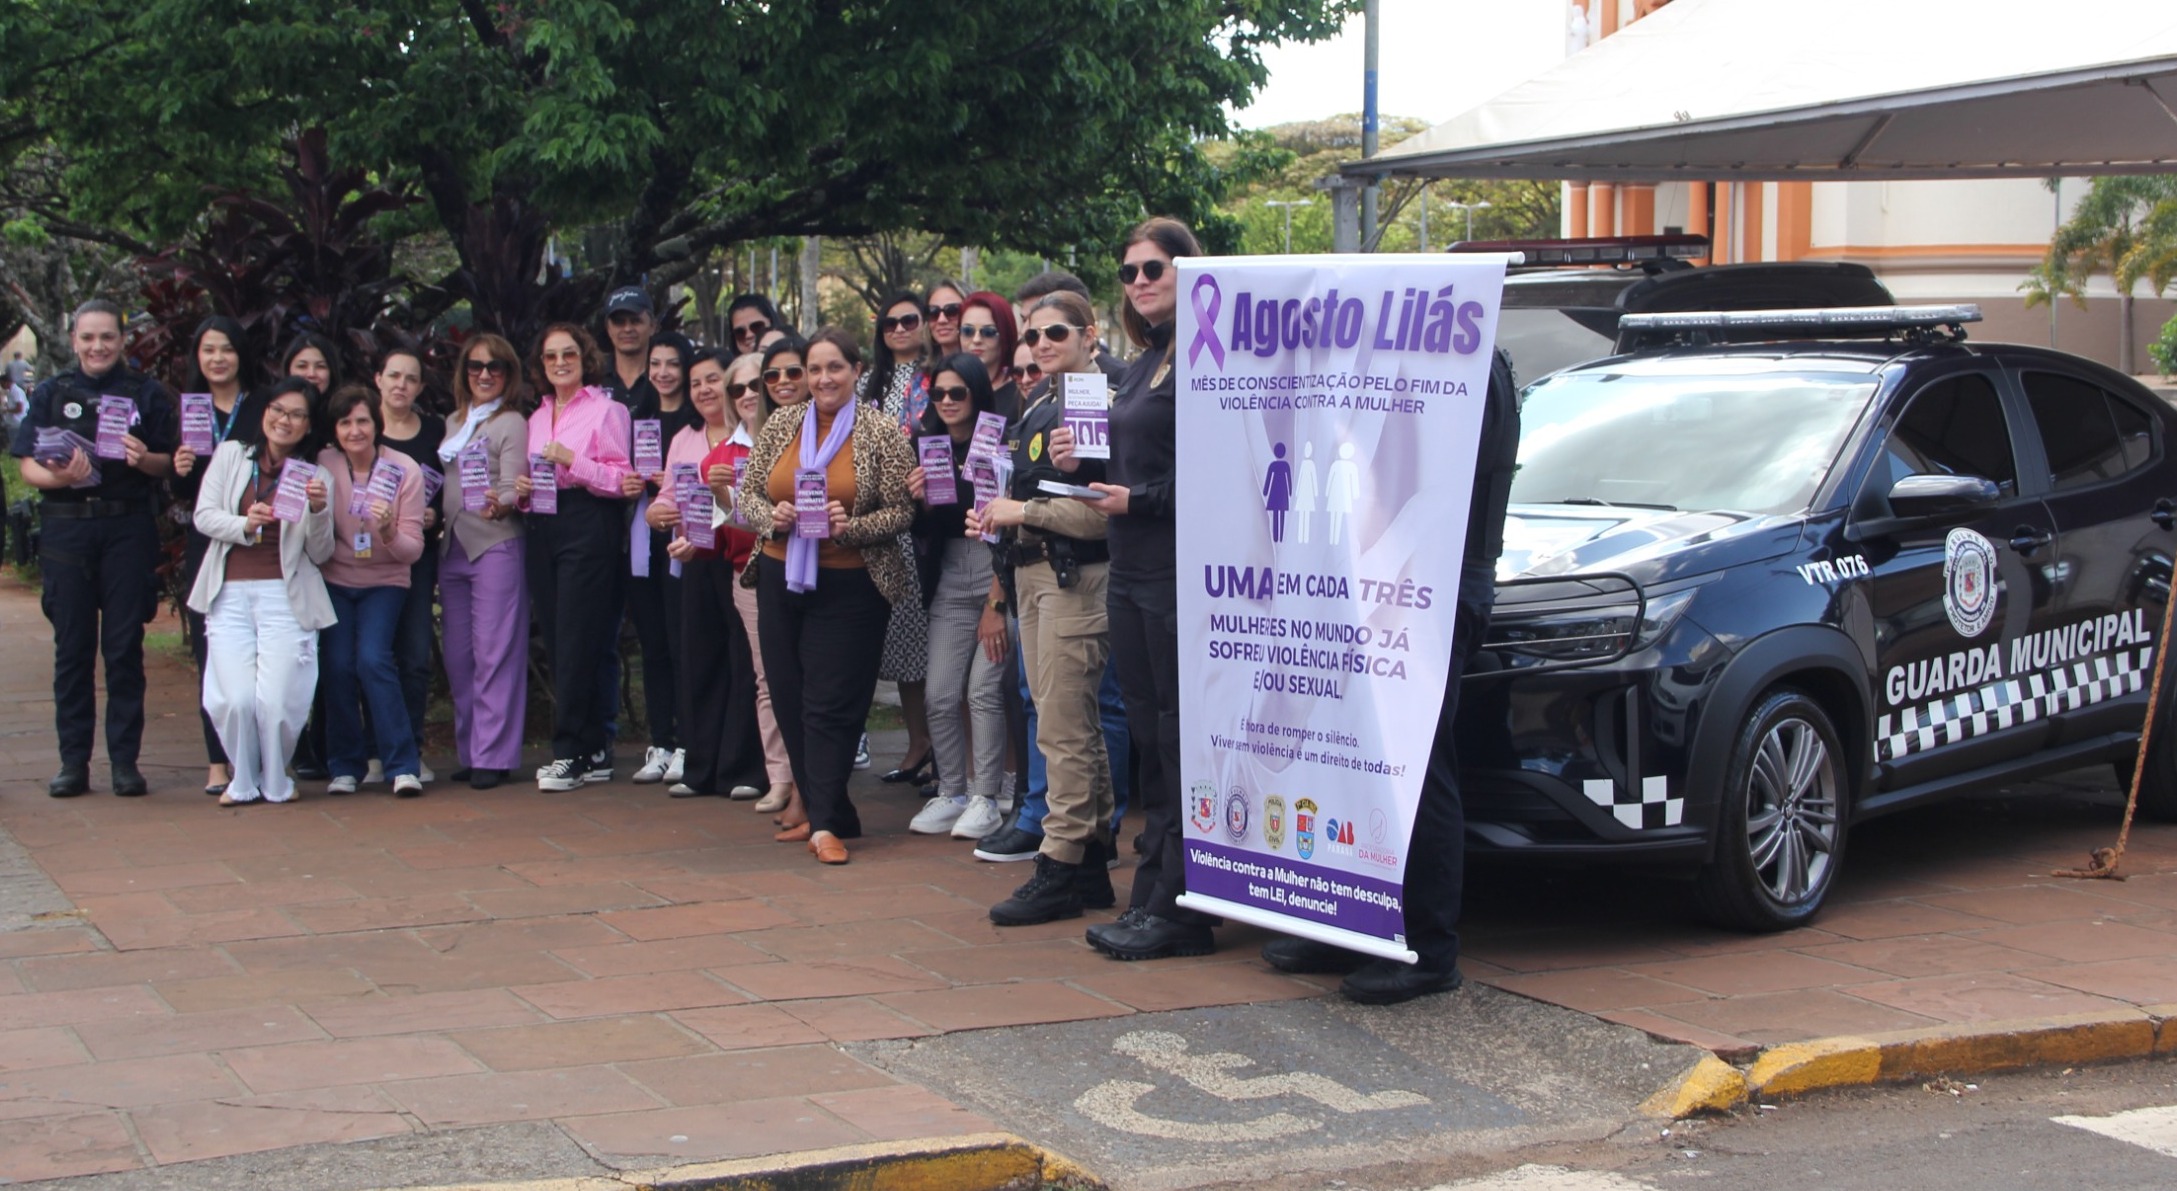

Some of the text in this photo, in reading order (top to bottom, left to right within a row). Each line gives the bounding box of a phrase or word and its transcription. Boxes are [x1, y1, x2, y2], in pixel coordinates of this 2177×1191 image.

[1231, 284, 1484, 358] Agosto Lilás
[1191, 372, 1468, 396] MÊS DE CONSCIENTIZAÇÃO PELO FIM DA
[1220, 394, 1425, 414] VIOLÊNCIA CONTRA A MULHER
[1204, 564, 1433, 610] UMA EM CADA TRÊS
[1796, 554, 1868, 586] VTR 076
[1210, 614, 1410, 652] MULHERES NO MUNDO JÁ
[1209, 640, 1408, 680] SOFREU VIOLÊNCIA FÍSICA
[1886, 608, 2150, 706] GUARDA MUNICIPAL
[1253, 669, 1343, 700] E/OU SEXUAL.
[1240, 718, 1360, 748] É hora de romper o silêncio.
[1210, 734, 1407, 778] Viver sem violência é um direito de todas!
[1326, 818, 1354, 846] OAB
[1358, 849, 1369, 860] DA
[1371, 852, 1398, 866] MULHER
[1190, 848, 1402, 913] Violência contra a Mulher não tem desculpa,
[1248, 882, 1337, 916] tem LEI, denuncie!
